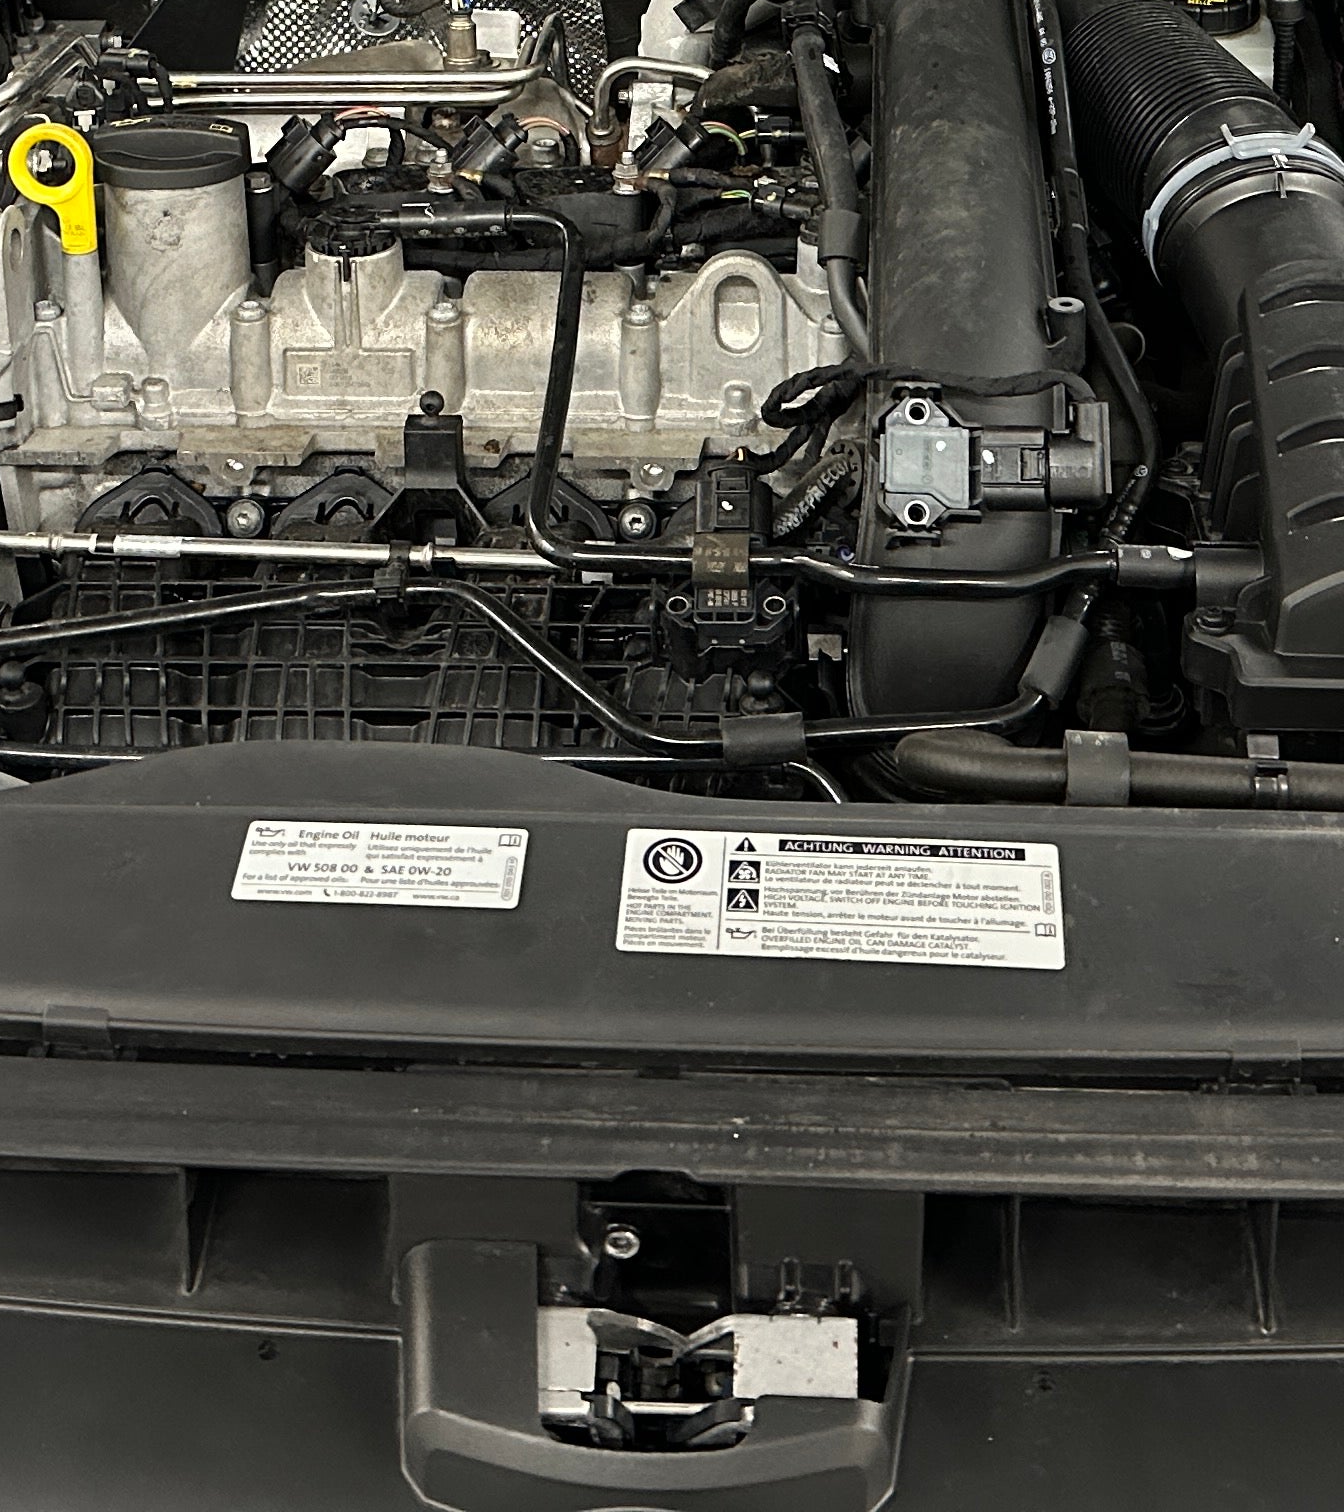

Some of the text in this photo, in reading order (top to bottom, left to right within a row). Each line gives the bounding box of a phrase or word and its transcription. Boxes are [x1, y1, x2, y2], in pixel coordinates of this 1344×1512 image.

[299, 830, 359, 841] Engine Oil
[370, 832, 450, 842] Huile moteur
[318, 842, 357, 850] expressly
[784, 841, 1016, 859] ACHTUNG WARNING ATTENTION
[288, 862, 311, 871] VW
[314, 863, 337, 872] 508
[341, 864, 358, 873] 00
[381, 865, 405, 874] SAE
[408, 866, 452, 876] 0W-20
[361, 876, 380, 884] Pour
[883, 898, 914, 906] ENGINE
[939, 916, 972, 924] toucher
[761, 935, 811, 944] OVERFILLED
[813, 937, 846, 945] ENGINE
